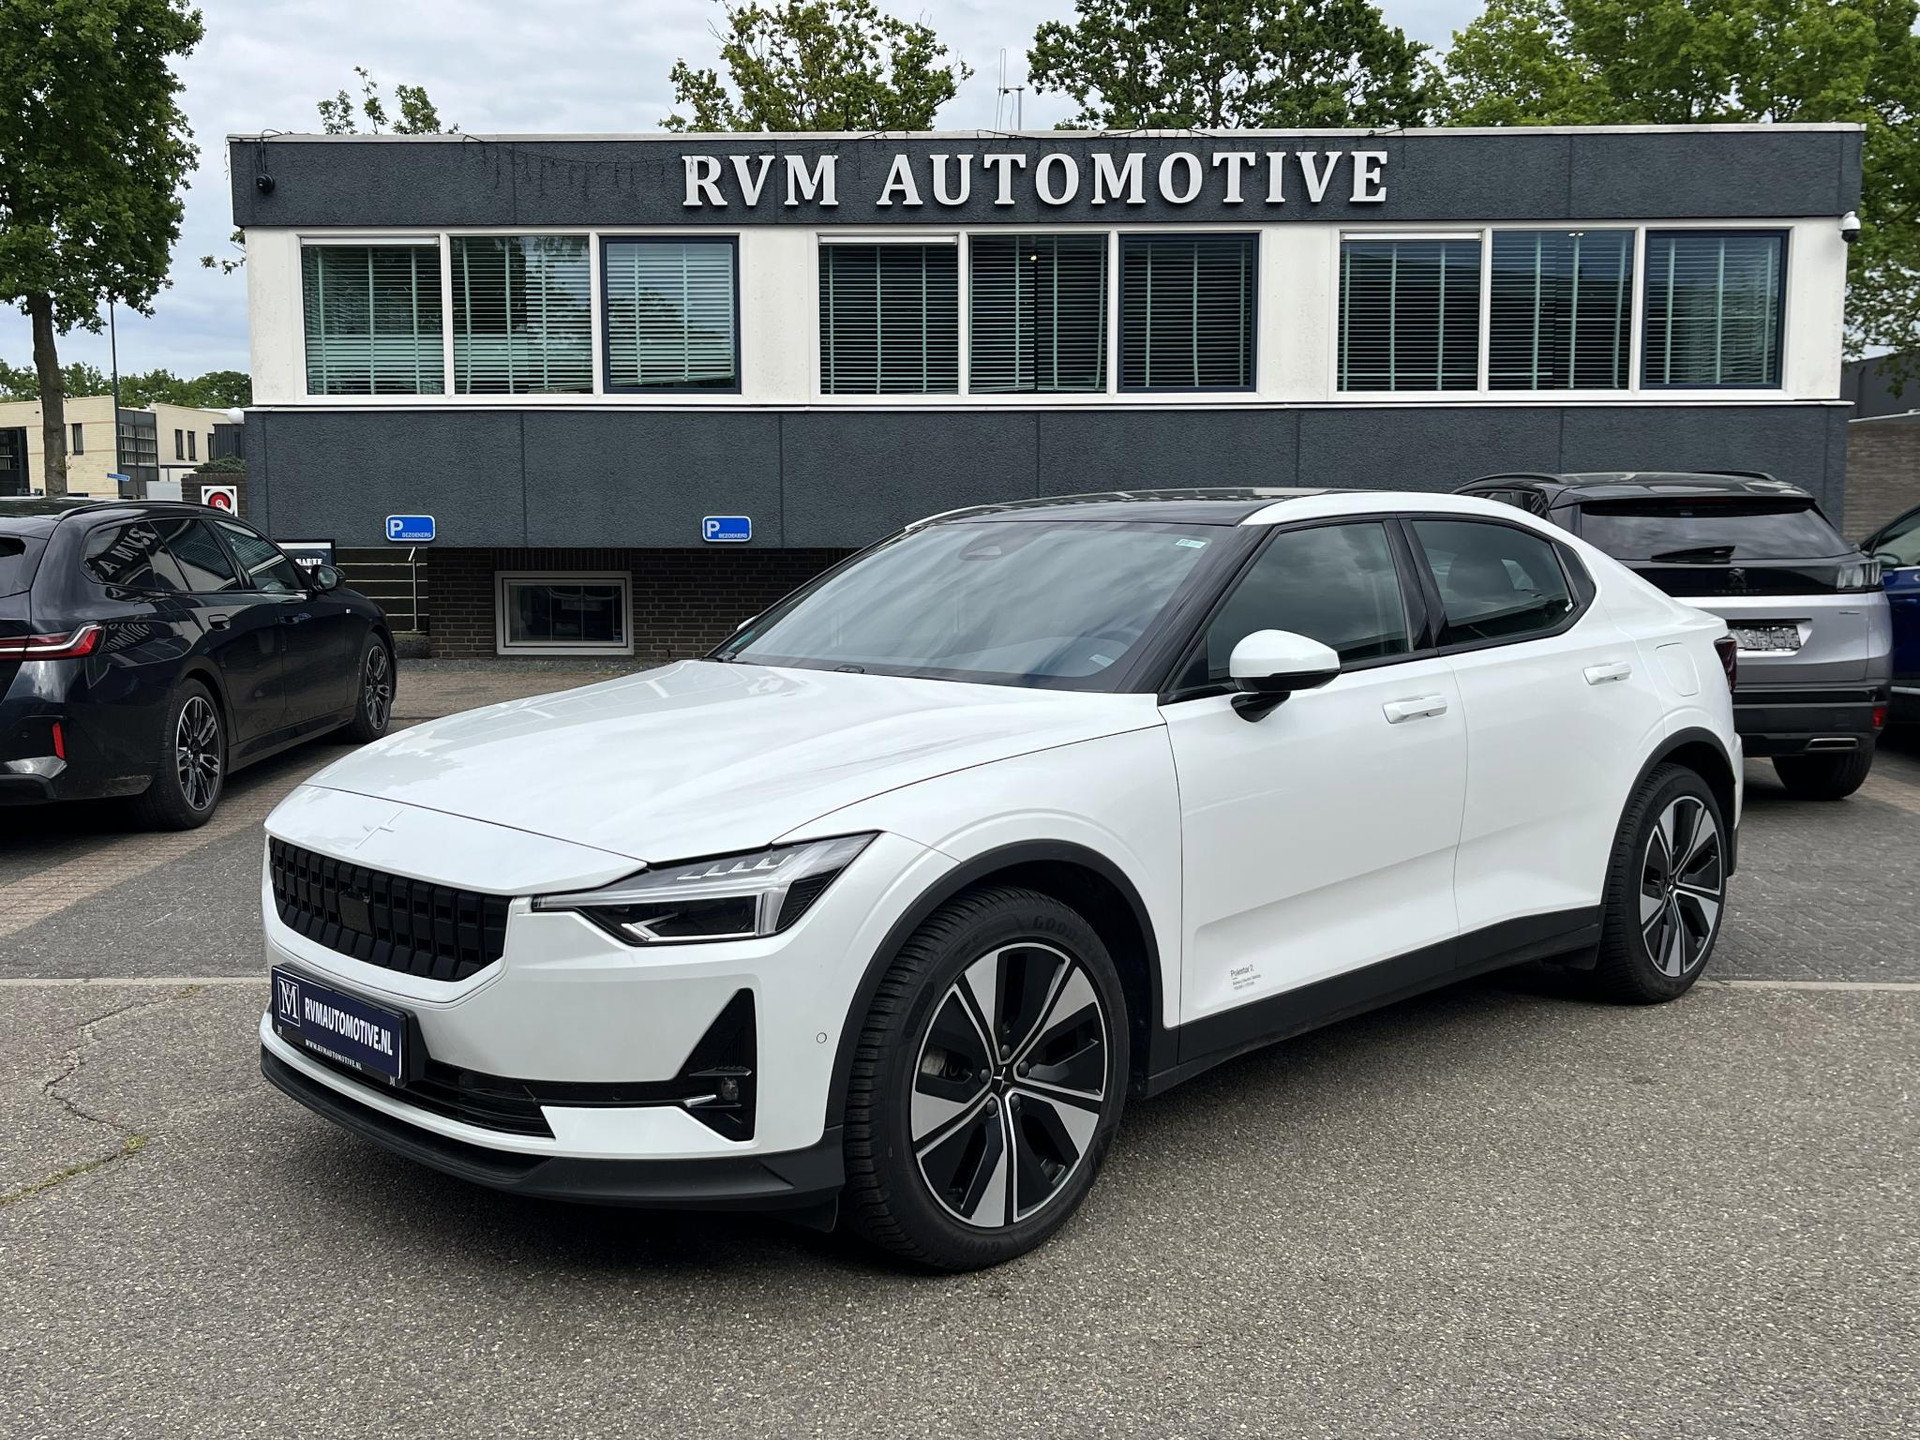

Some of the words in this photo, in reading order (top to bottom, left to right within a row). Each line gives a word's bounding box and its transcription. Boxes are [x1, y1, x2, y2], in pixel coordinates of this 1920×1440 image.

[682, 154, 839, 206] RVM
[876, 151, 1388, 206] AUTOMOTIVE
[390, 519, 404, 537] P
[706, 520, 720, 537] P
[304, 997, 393, 1056] RVMAUTOMOTIVE.NL
